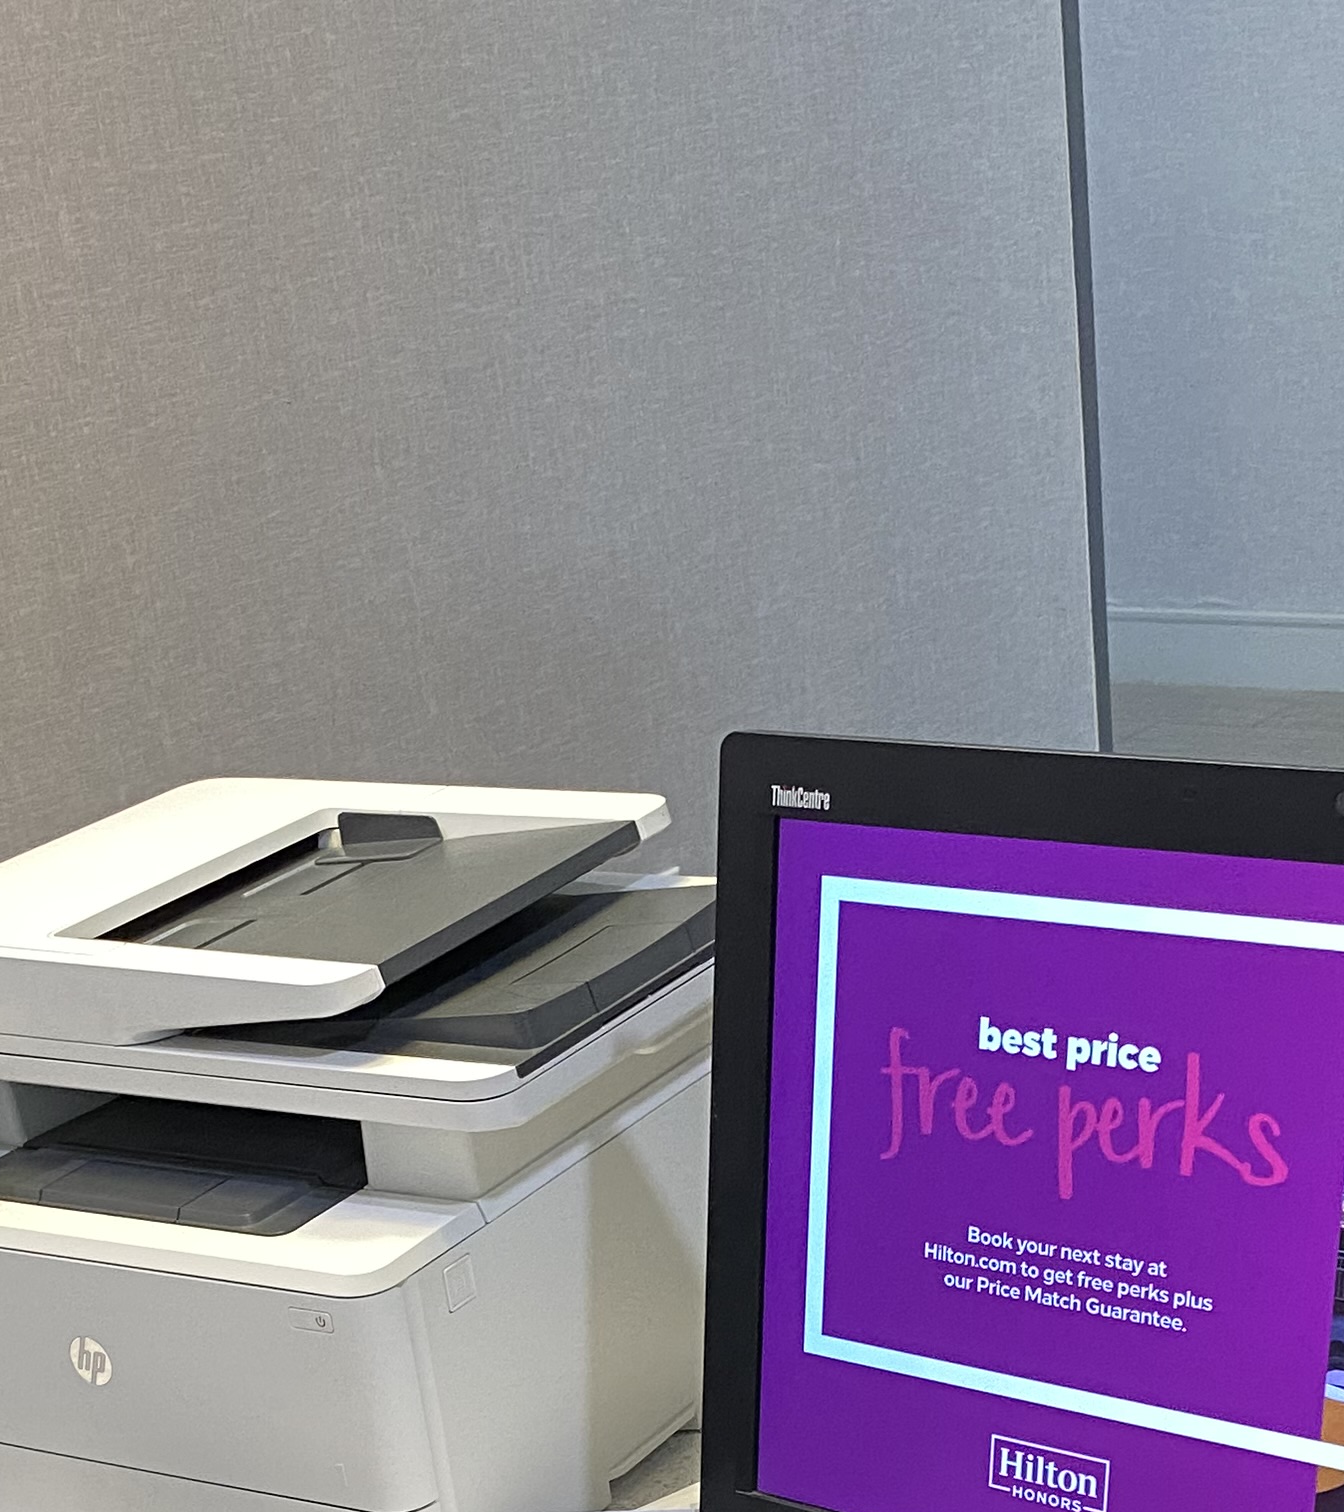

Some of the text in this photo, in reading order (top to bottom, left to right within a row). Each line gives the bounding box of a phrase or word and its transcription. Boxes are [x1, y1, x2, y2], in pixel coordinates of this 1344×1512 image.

[771, 785, 830, 810] ThinkCentre
[979, 1016, 1162, 1073] best price
[880, 1027, 1289, 1199] free perks
[924, 1242, 1213, 1312] Hilton.com to get free perks plus
[968, 1225, 1168, 1278] Book your next stay at
[944, 1274, 1188, 1333] our Price Match Guarantee.
[75, 1336, 109, 1386] hp
[999, 1447, 1097, 1498] Hilton
[1012, 1485, 1082, 1512] HONORS
